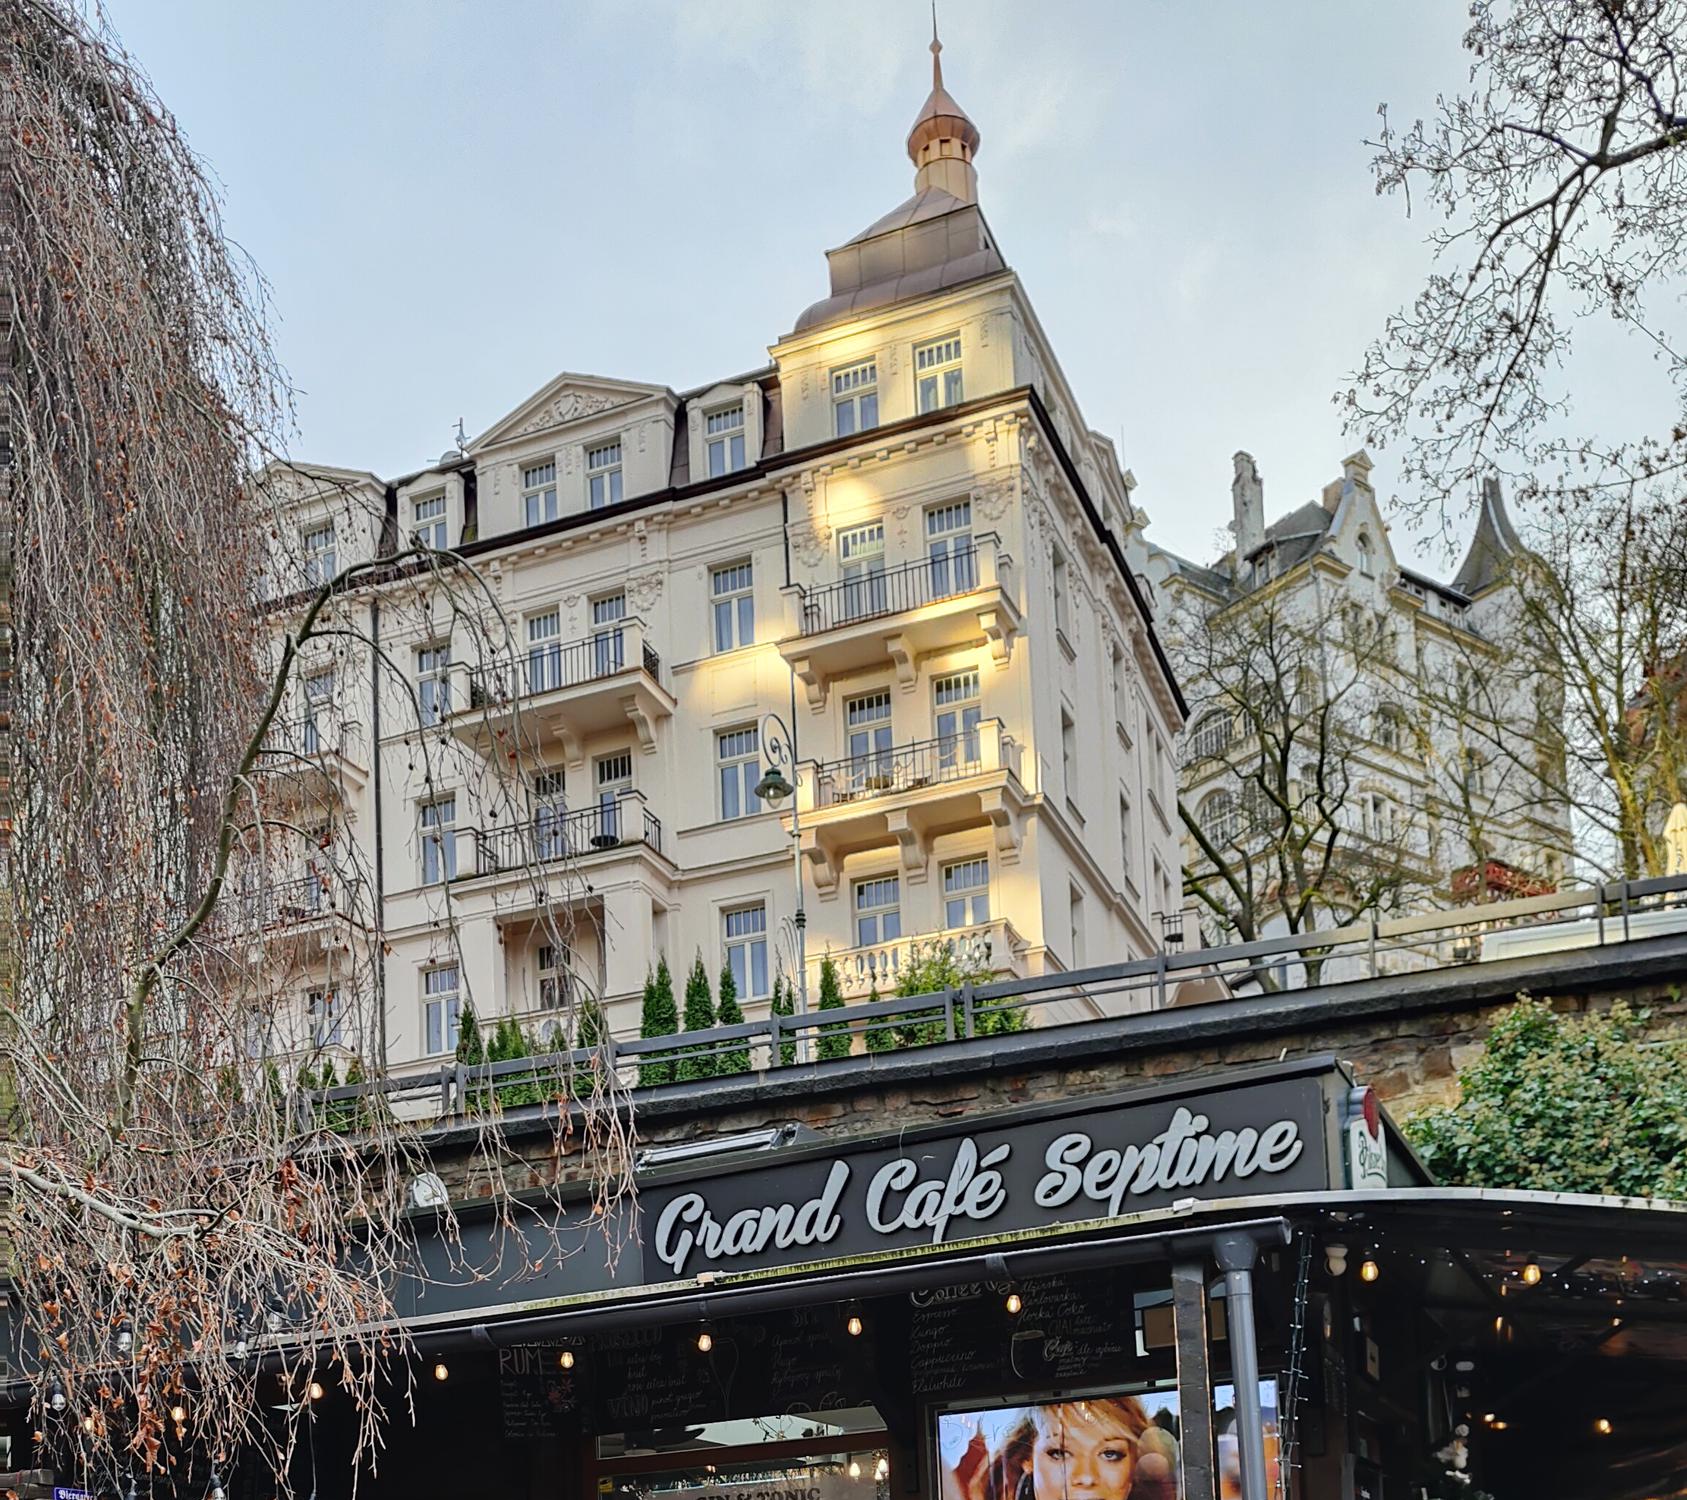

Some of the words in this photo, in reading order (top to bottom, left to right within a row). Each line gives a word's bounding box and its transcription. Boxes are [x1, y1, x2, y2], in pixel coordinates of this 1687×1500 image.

[654, 1159, 851, 1276] Grand
[866, 1137, 1011, 1244] Café
[1034, 1106, 1304, 1218] Septime
[498, 1347, 543, 1376] RUM
